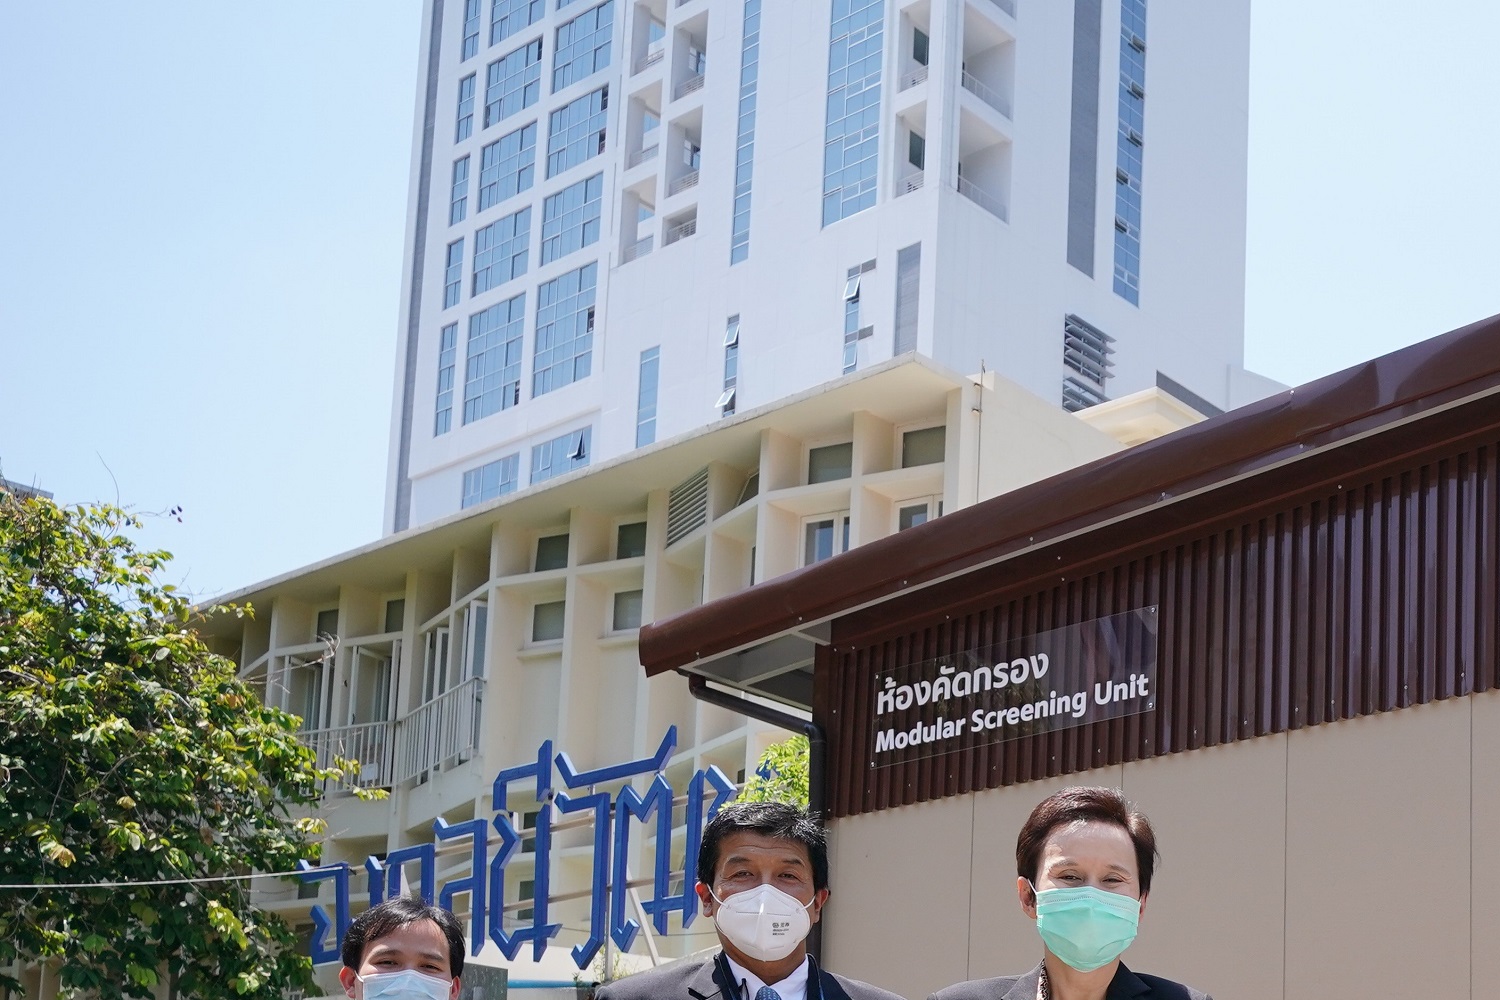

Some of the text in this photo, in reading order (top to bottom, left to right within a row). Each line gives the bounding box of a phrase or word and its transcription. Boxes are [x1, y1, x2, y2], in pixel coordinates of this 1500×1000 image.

[874, 672, 1150, 753] Modular Screening Unit
[876, 652, 1050, 715] ห้องคัดกรอง
